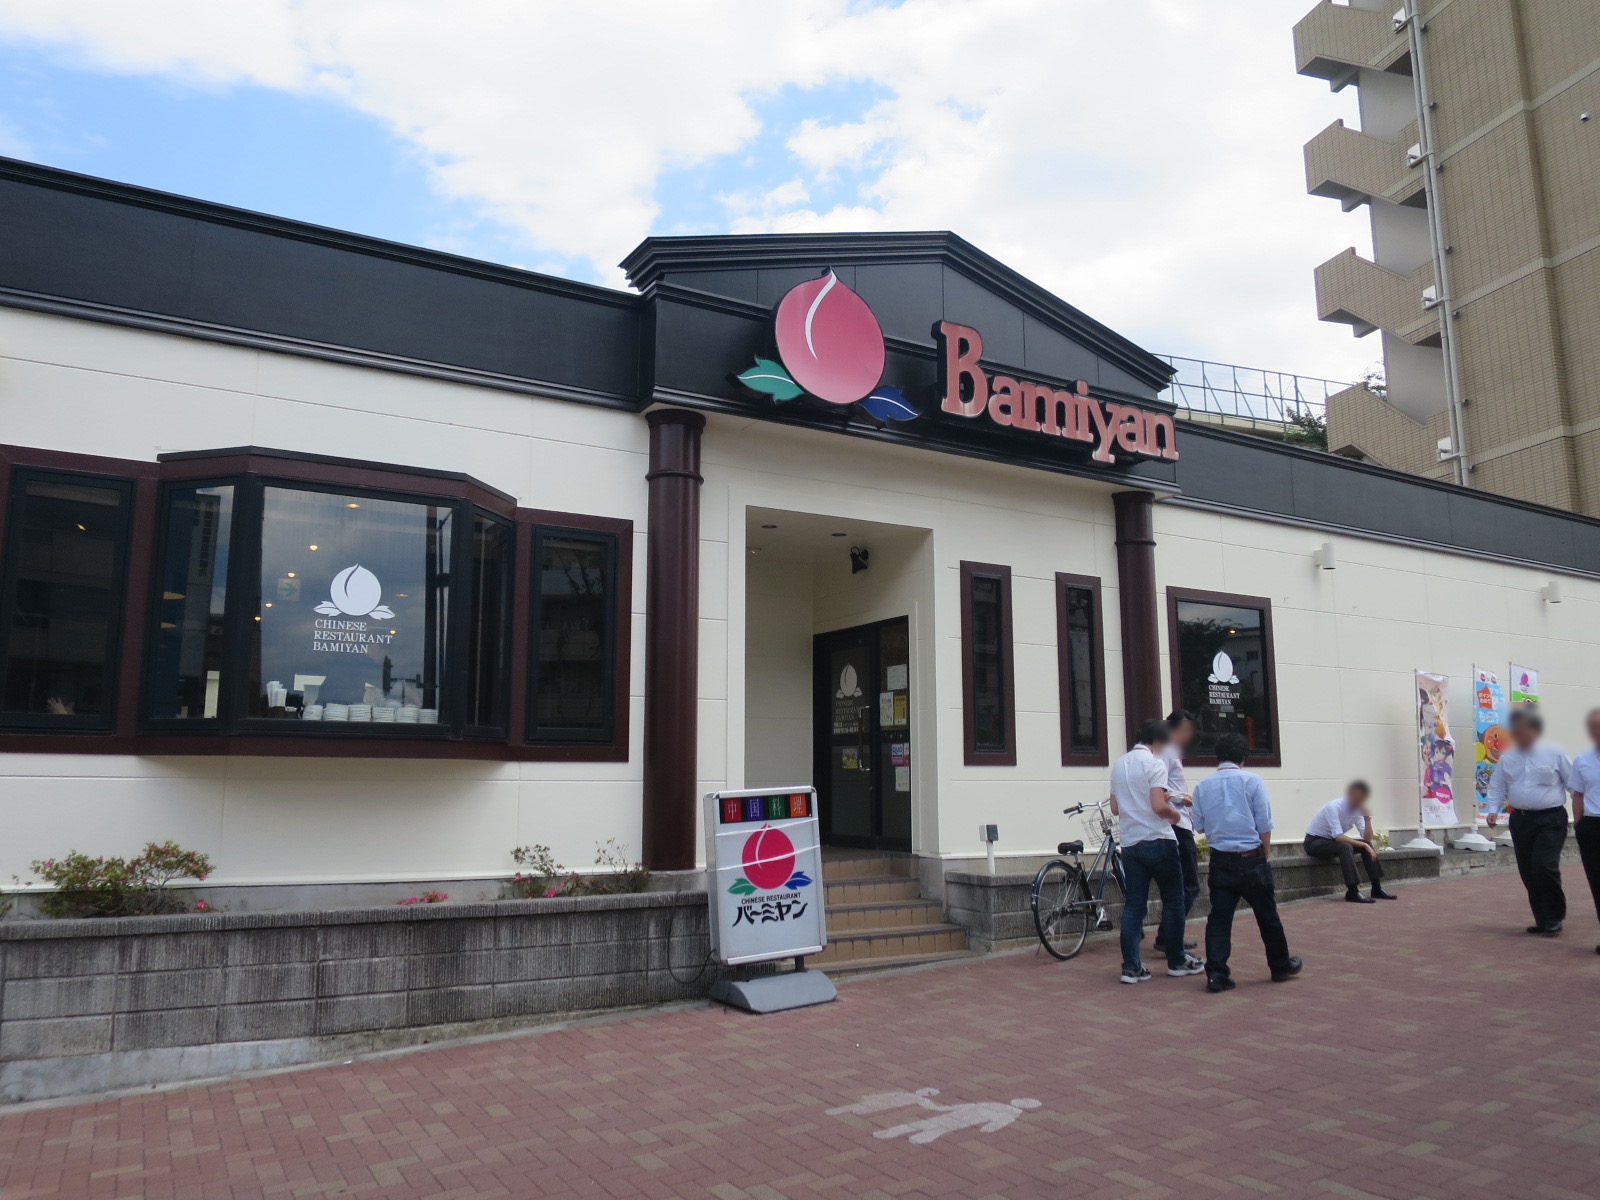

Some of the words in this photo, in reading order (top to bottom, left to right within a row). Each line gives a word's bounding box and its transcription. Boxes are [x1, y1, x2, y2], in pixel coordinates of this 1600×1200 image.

[939, 318, 1180, 464] Bamiyan
[315, 619, 367, 631] CHINESE
[313, 631, 393, 644] RESTAURANT
[313, 642, 369, 653] BAMIYAN
[1209, 691, 1240, 699] RESTAURANT
[727, 796, 803, 820] 中国料理
[741, 896, 765, 904] CHINESE
[766, 893, 802, 902] RESTAURANT
[731, 899, 809, 928] バーミヤン
